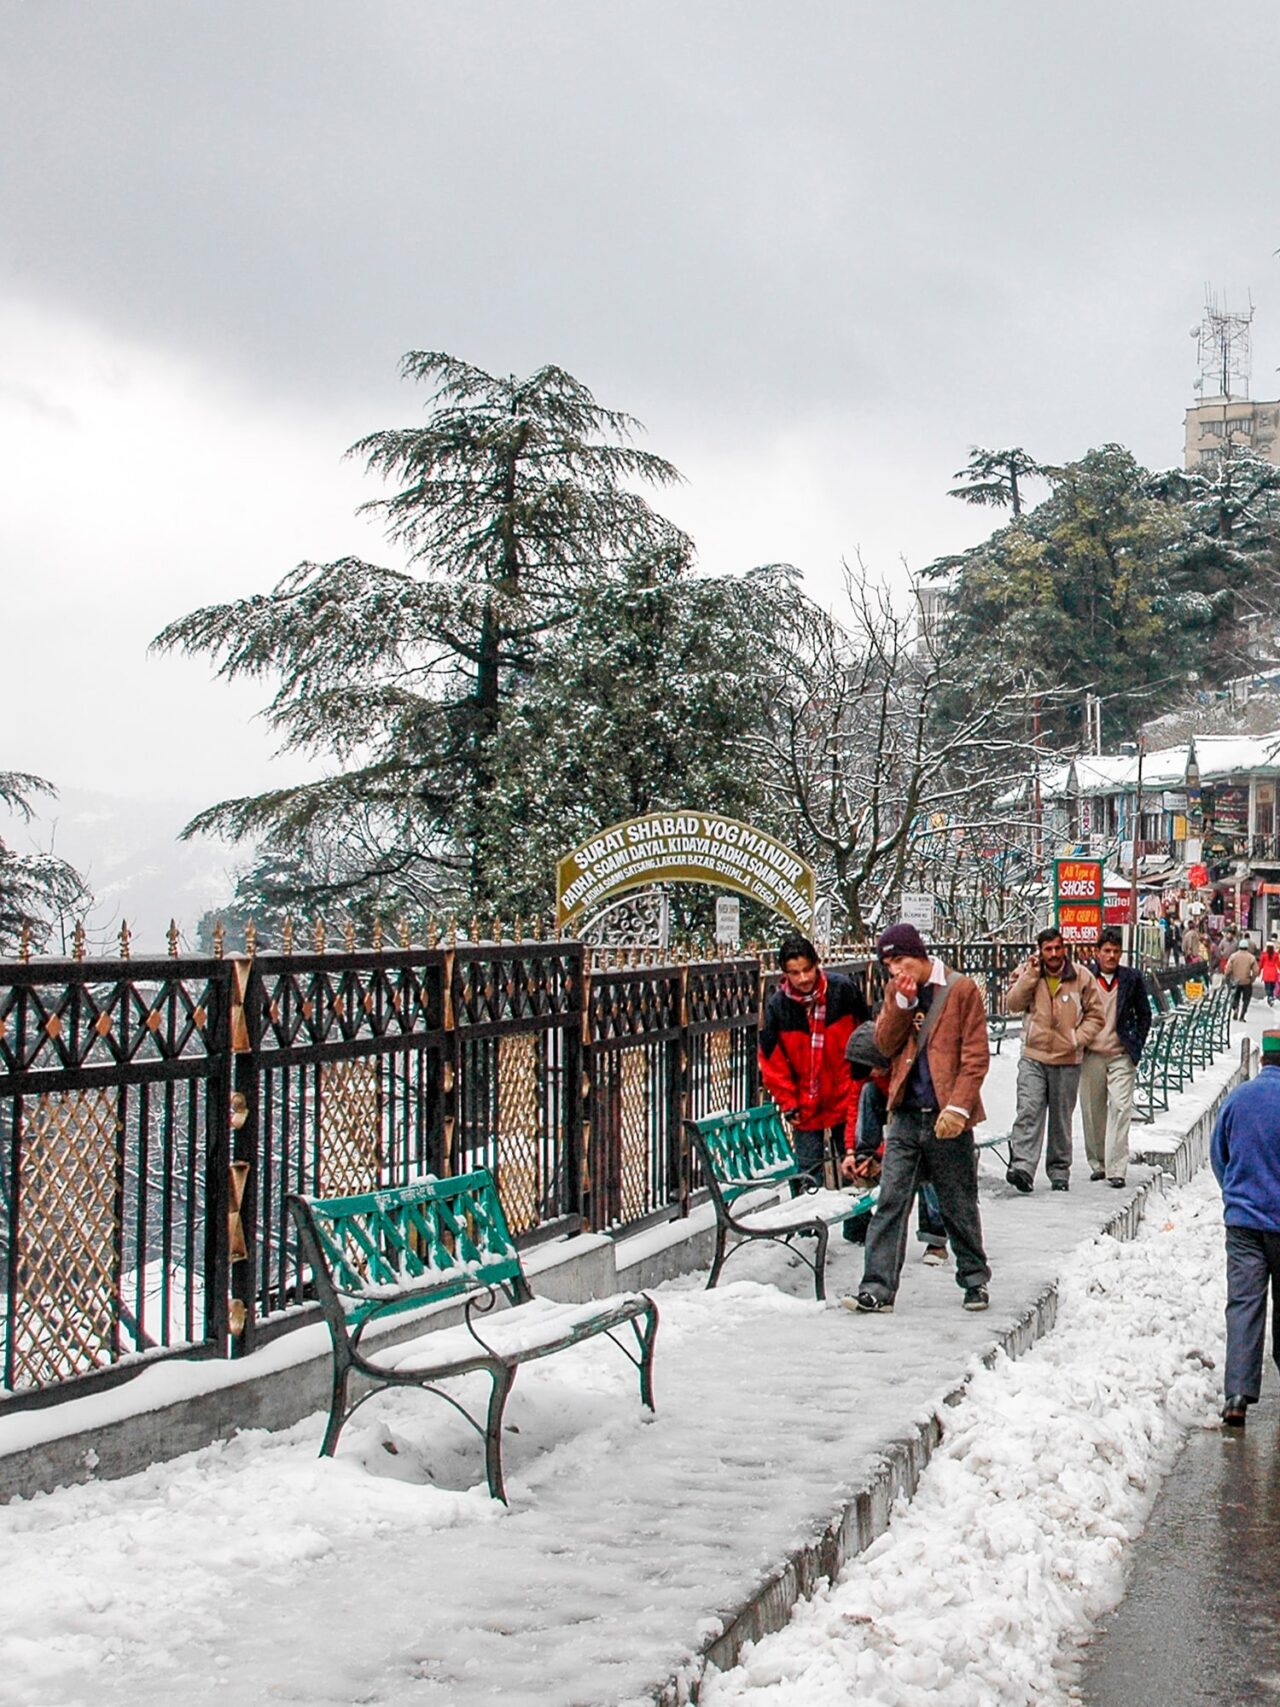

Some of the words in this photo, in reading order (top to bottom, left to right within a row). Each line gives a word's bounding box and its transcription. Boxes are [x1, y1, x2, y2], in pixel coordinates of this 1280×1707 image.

[574, 829, 625, 869] SURAT
[627, 818, 700, 842] SHABAD
[702, 819, 739, 843] YOG
[738, 830, 804, 884] MANDIR
[687, 855, 715, 869] BAZAR
[716, 861, 752, 886] SHIMLA
[561, 870, 597, 911] RADHA
[593, 849, 631, 878] SOAMI
[629, 839, 668, 860] DAYAL
[710, 840, 750, 869] RADHA
[747, 858, 781, 889] SOAMI
[774, 877, 813, 925] SAHAYA
[1060, 880, 1095, 896] SHOES
